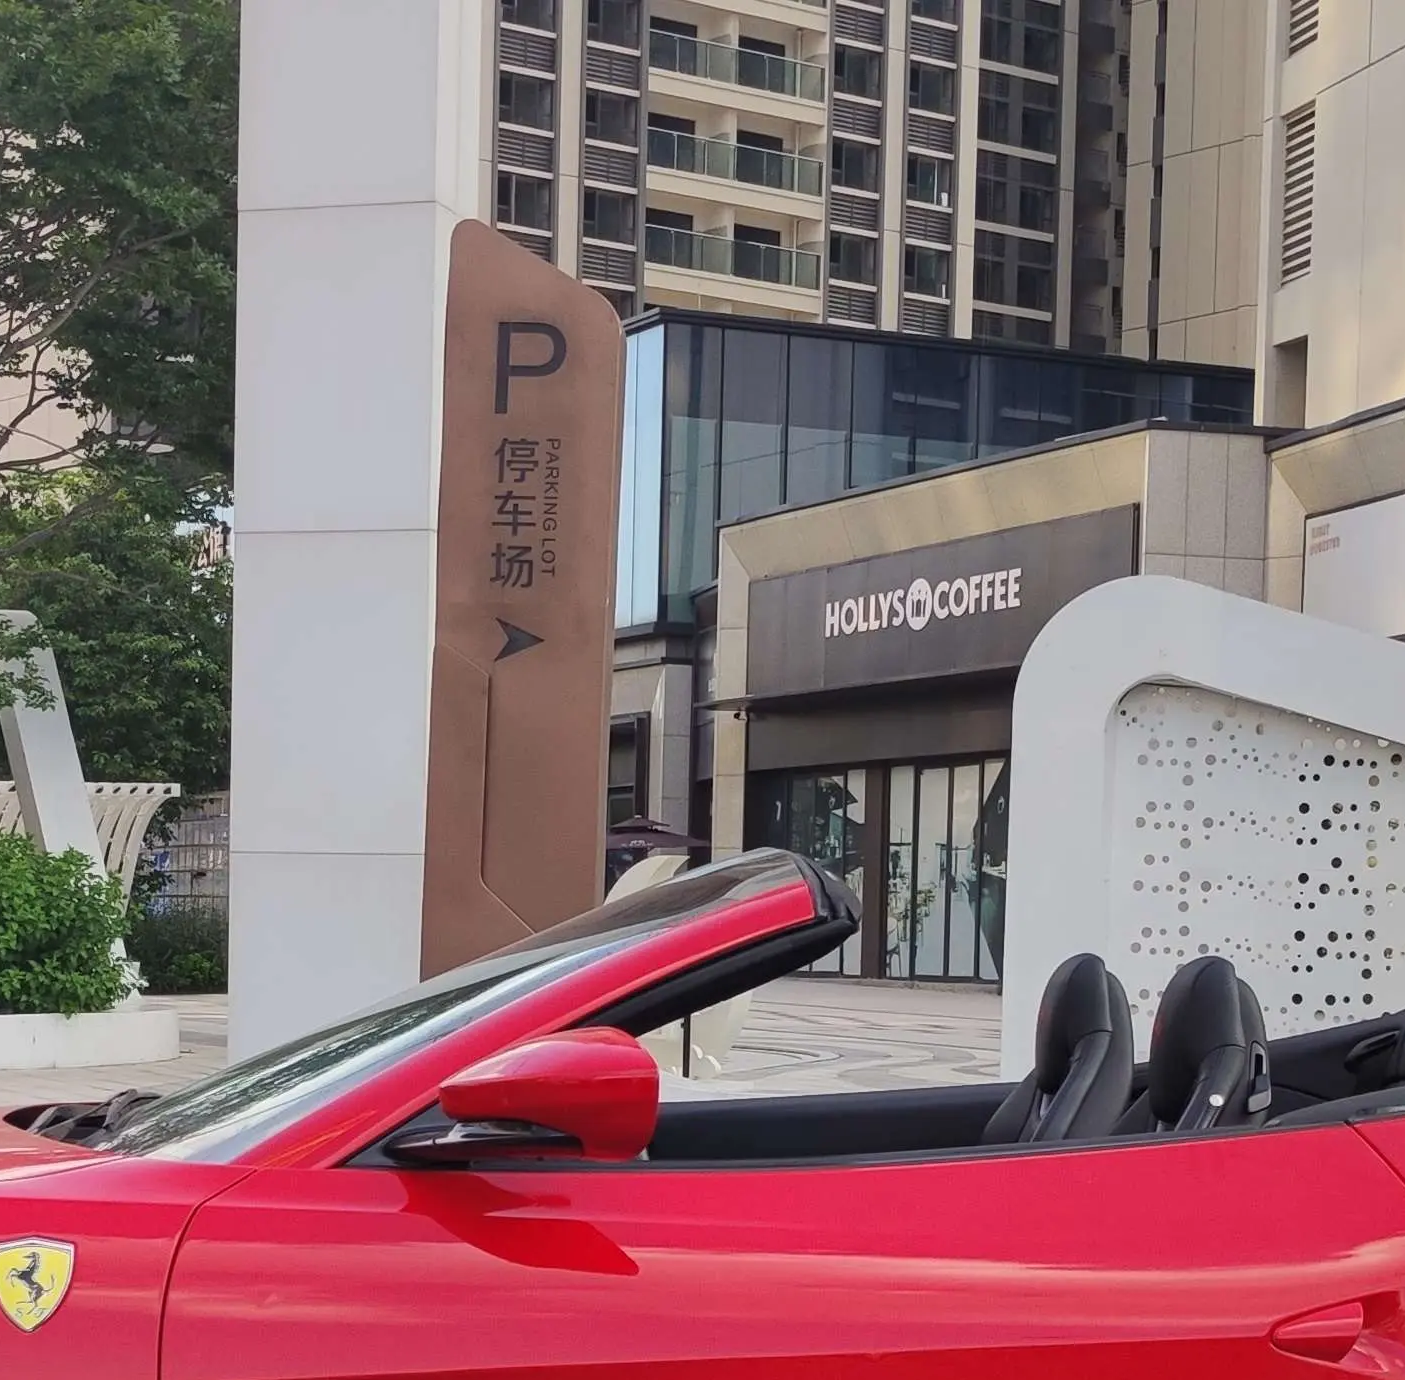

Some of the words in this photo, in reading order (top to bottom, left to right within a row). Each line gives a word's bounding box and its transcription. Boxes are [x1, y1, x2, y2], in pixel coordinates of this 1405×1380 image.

[494, 321, 568, 415] P
[489, 437, 540, 589] 停车场
[542, 437, 562, 532] PARKING
[540, 538, 557, 578] LOT
[824, 588, 906, 638] HOLLYS
[933, 567, 1022, 620] COFFEE
